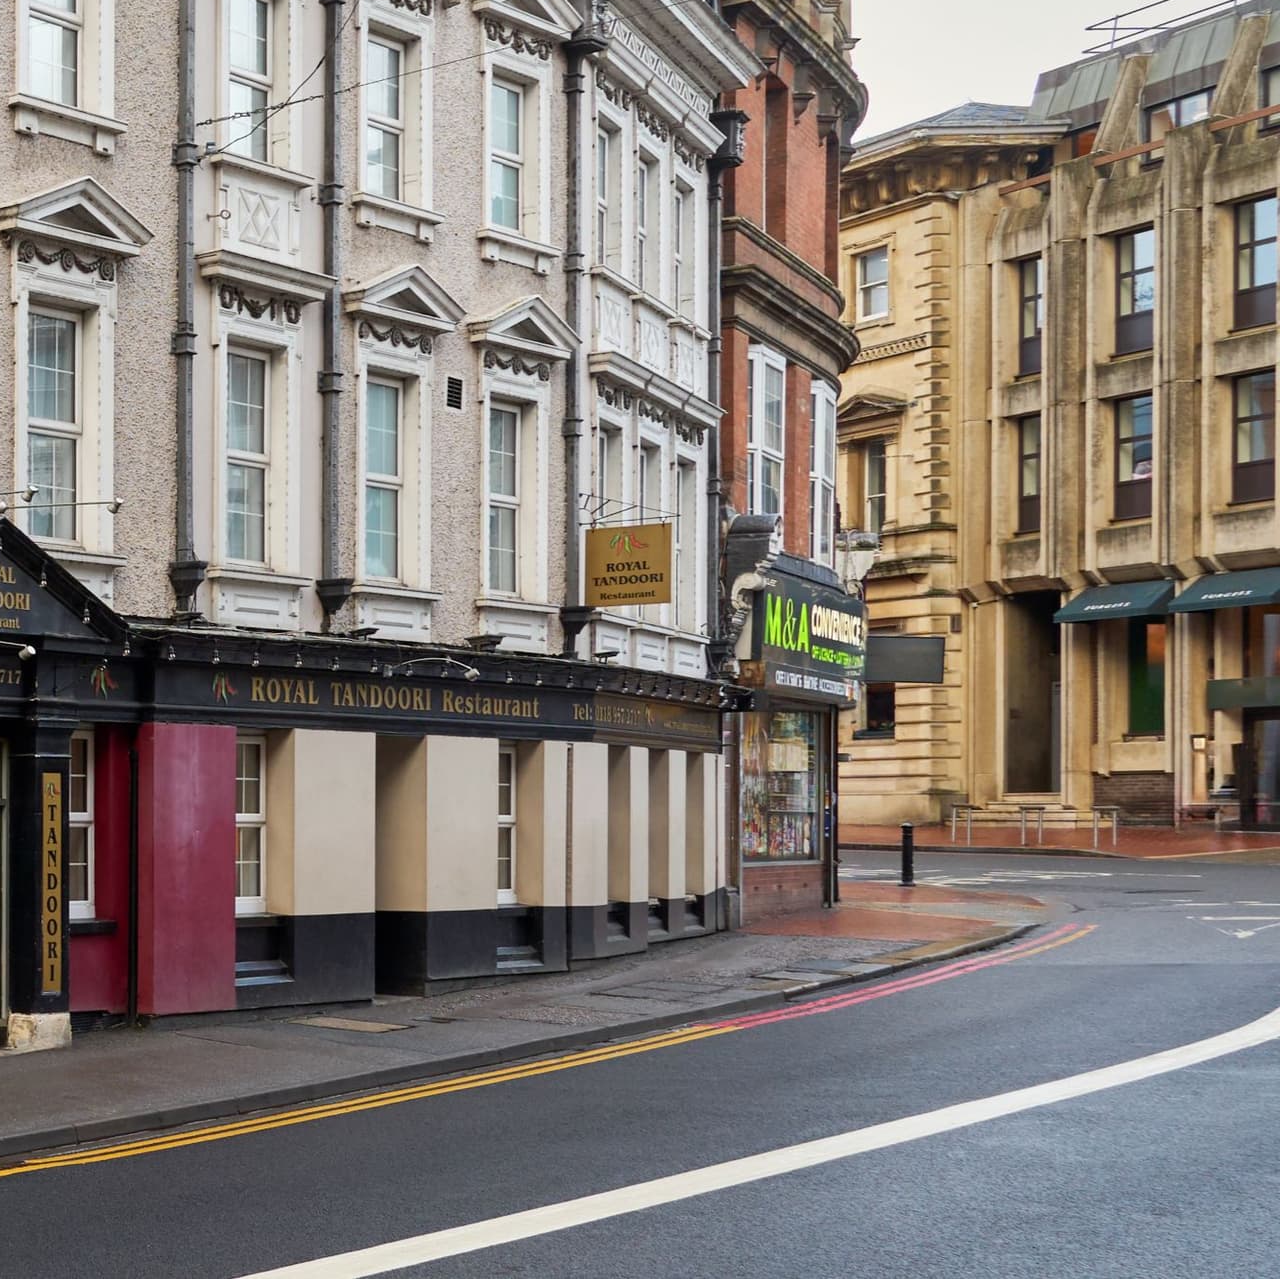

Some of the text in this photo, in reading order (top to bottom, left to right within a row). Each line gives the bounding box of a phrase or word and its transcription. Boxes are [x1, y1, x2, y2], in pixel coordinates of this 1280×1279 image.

[606, 560, 650, 572] ROYAL
[592, 573, 664, 587] TANDOORI
[600, 590, 657, 600] Restaurant
[764, 592, 862, 653] M&A CONVENIENCE
[251, 676, 540, 719] ROYAL TANDOORI Restaurant
[572, 703, 593, 721] Tel:
[594, 704, 612, 722] 0118
[46, 804, 58, 982] TANDOORI
